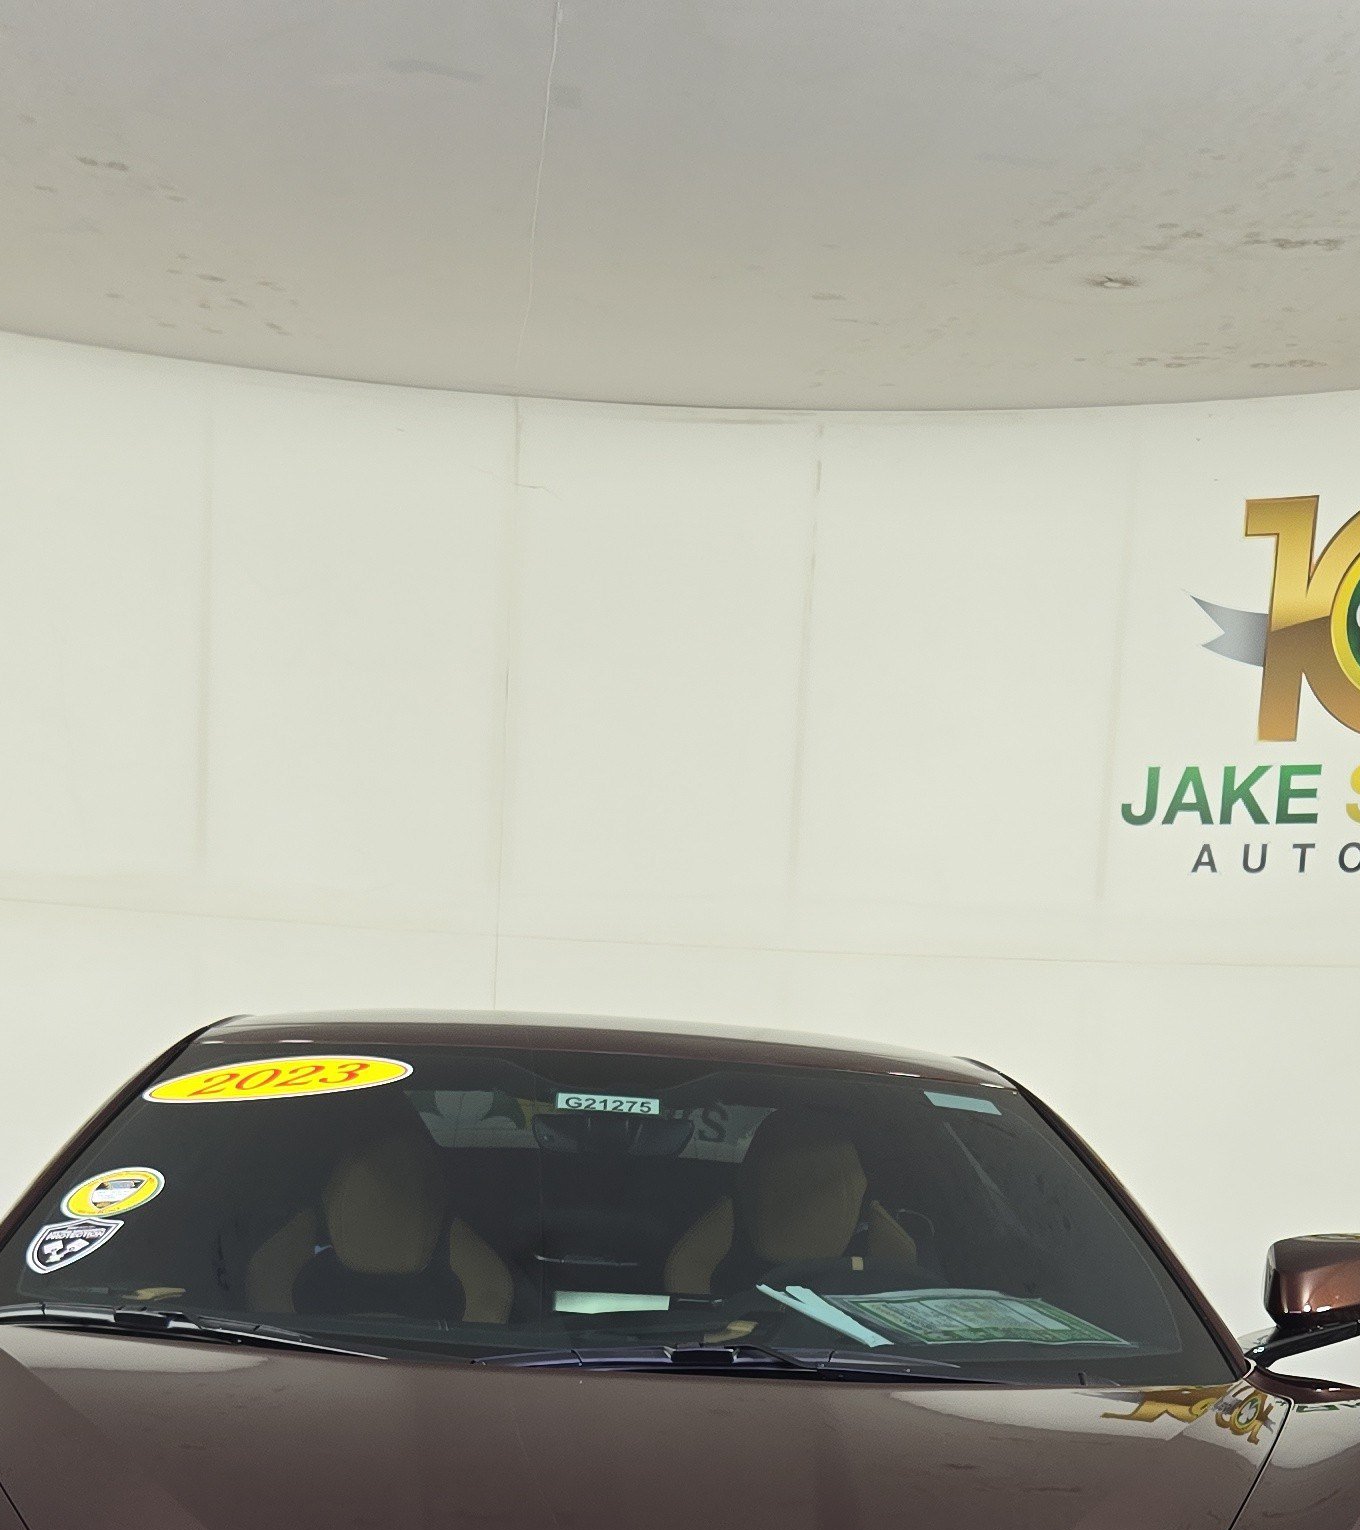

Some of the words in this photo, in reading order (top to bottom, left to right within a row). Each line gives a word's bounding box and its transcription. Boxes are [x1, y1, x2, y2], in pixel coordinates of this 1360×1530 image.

[1120, 764, 1323, 827] JAKE
[187, 1062, 370, 1097] 2023
[565, 1097, 652, 1114] G21275
